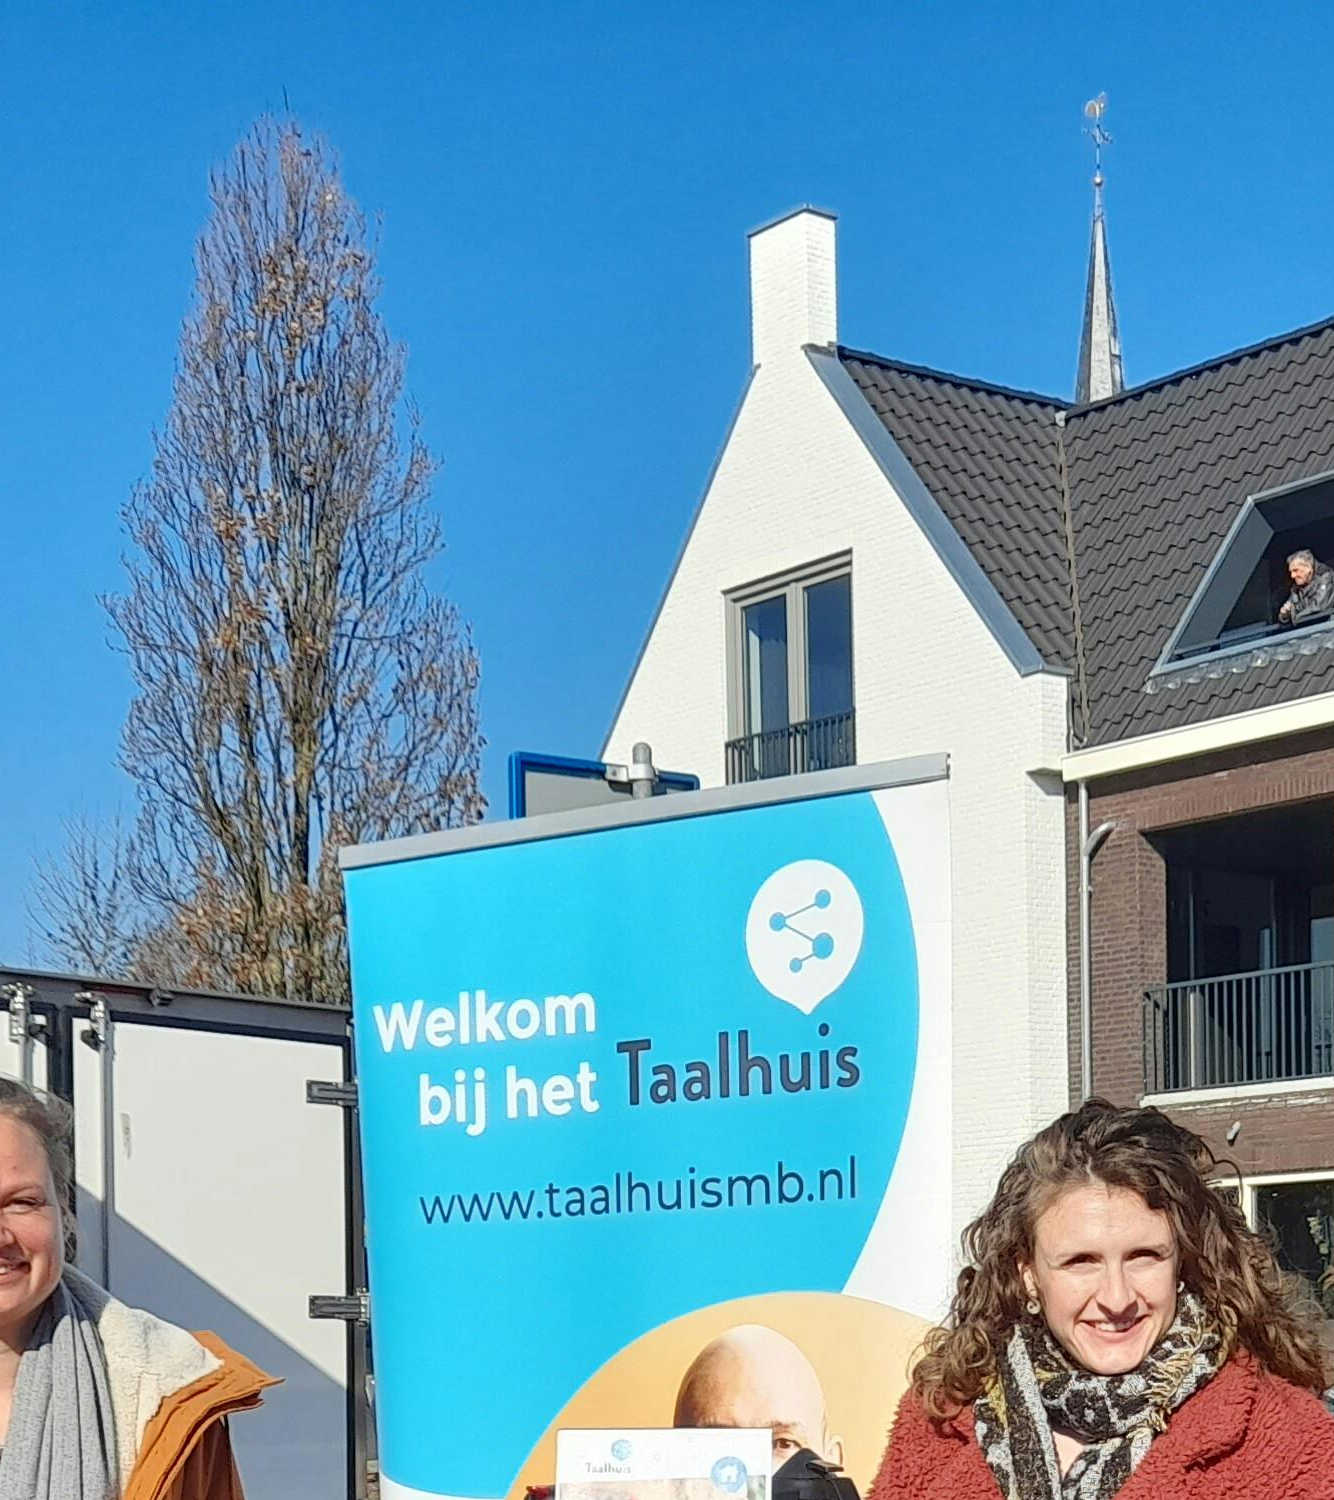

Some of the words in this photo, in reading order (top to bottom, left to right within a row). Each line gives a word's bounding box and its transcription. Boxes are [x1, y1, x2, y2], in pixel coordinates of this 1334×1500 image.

[373, 989, 596, 1053] Welkom
[419, 1064, 488, 1136] bij
[506, 1060, 599, 1119] het
[617, 1022, 860, 1106] Taalhuis
[420, 1156, 858, 1224] www.taalhuismb.nl
[585, 1461, 632, 1474] Taalhuis
